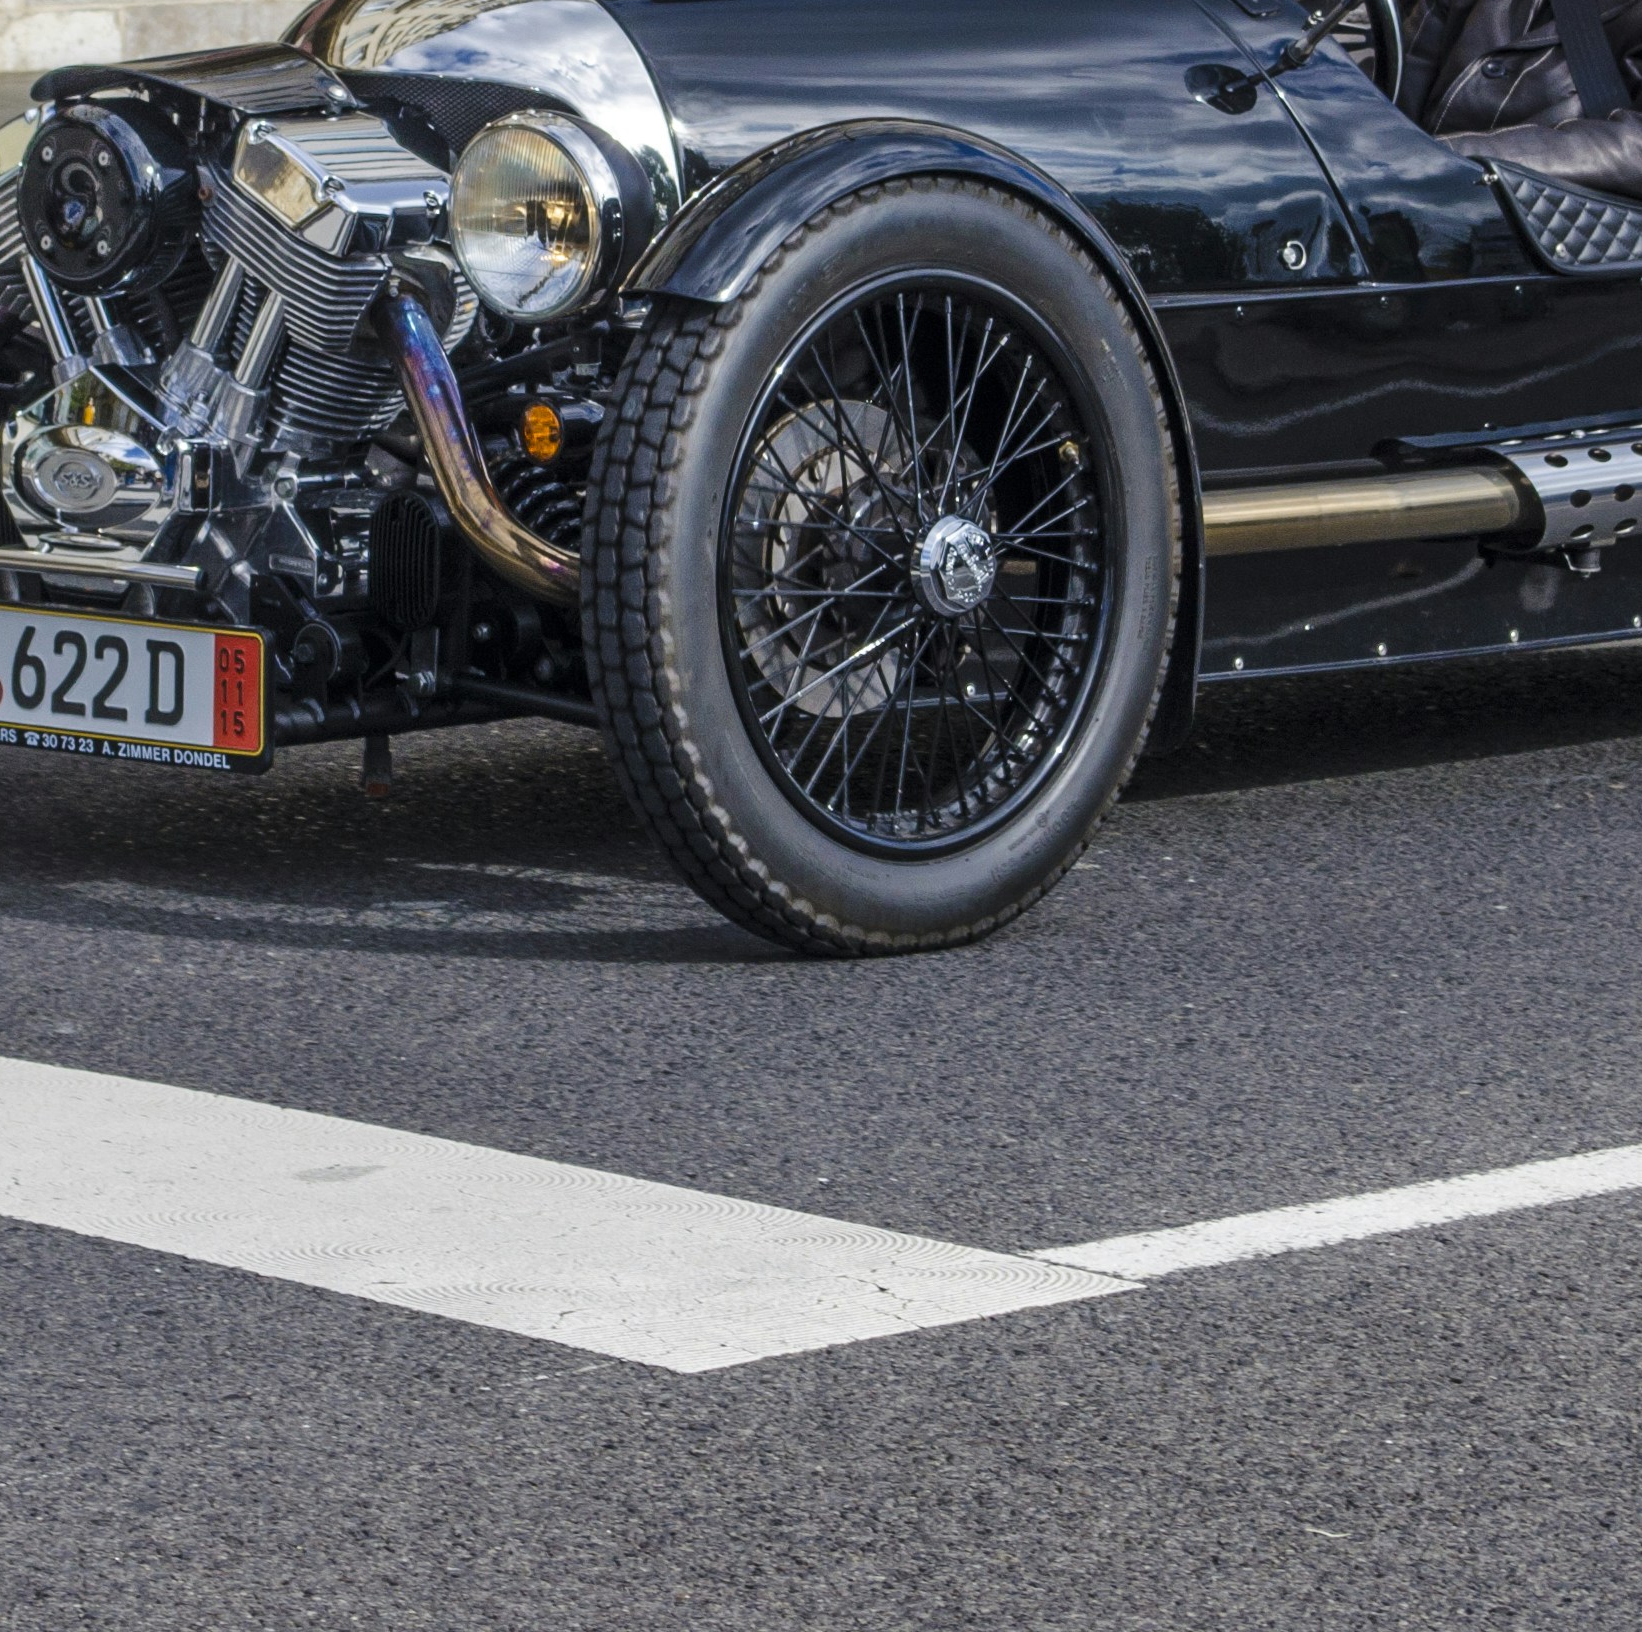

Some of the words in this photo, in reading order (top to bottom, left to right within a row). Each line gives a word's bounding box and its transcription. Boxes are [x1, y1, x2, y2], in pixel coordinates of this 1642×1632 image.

[218, 647, 245, 675] 05
[221, 679, 244, 706] 11
[220, 709, 245, 736] 15
[41, 734, 58, 749] 30
[61, 735, 76, 752] 73
[78, 738, 94, 754] 23
[101, 742, 115, 757] A.
[118, 742, 171, 763] ZIMMER
[174, 749, 231, 770] DONDEL
